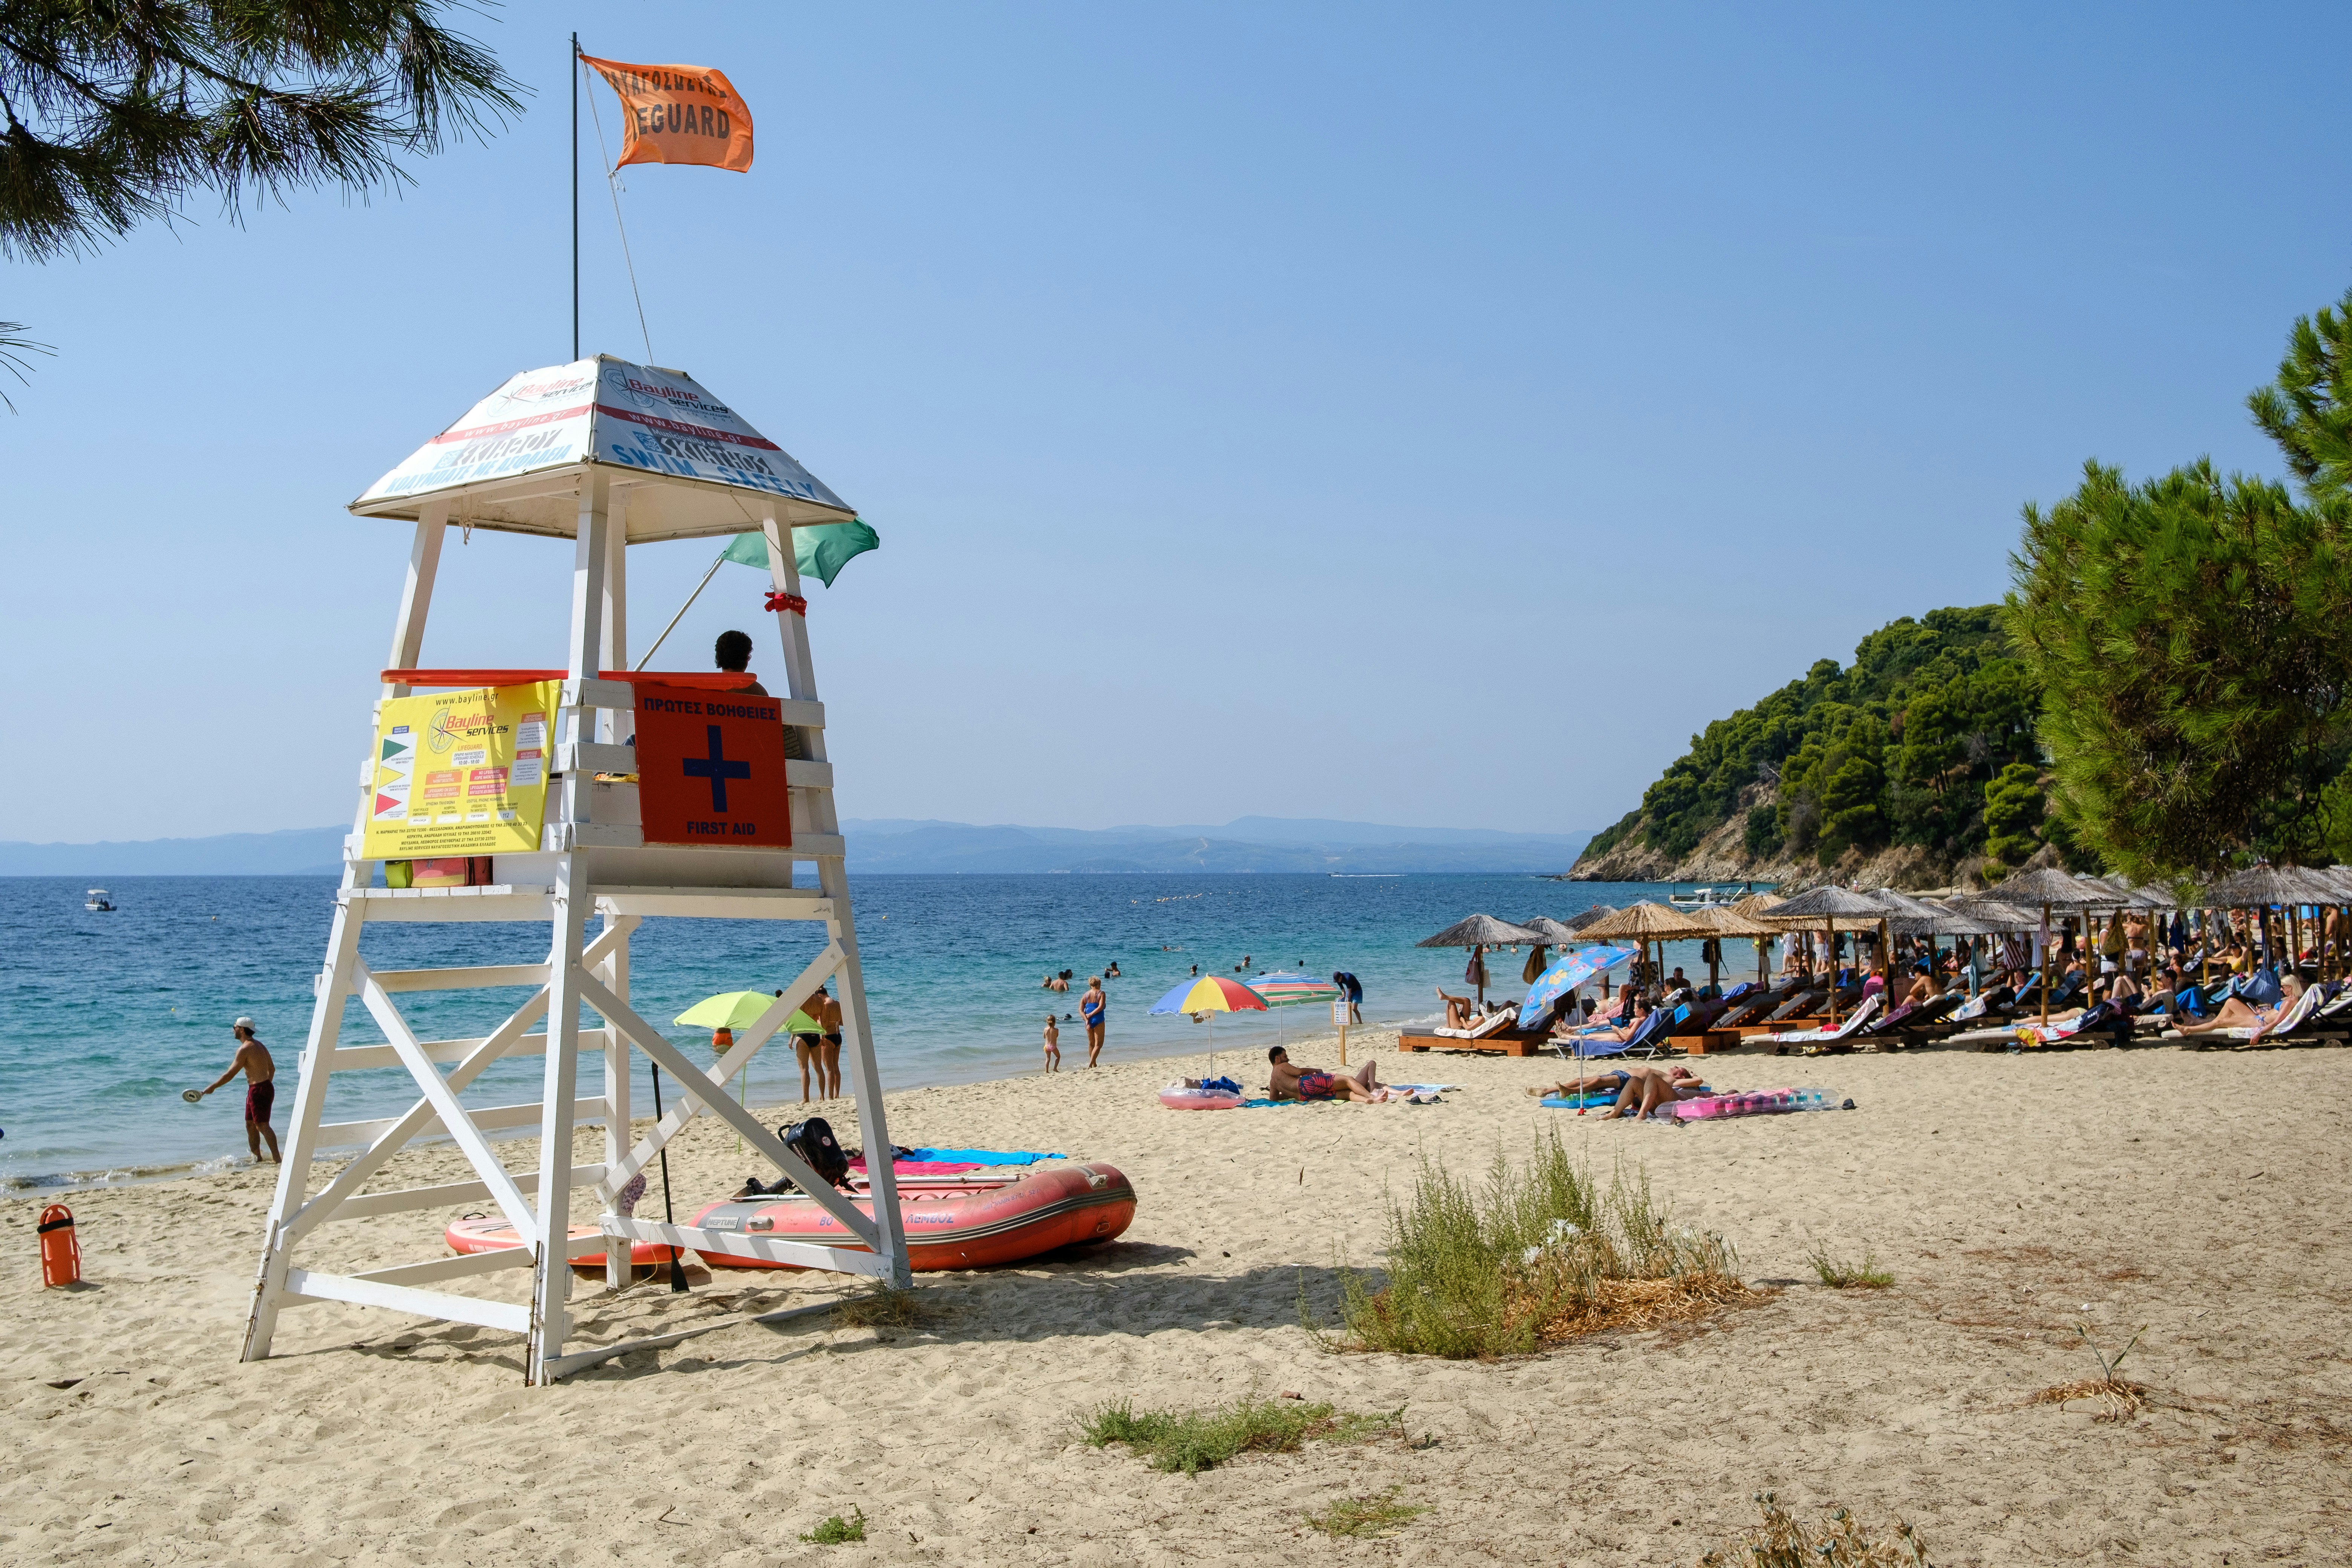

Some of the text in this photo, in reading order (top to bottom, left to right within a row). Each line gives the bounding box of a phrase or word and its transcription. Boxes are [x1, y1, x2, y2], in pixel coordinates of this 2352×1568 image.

[632, 104, 730, 142] EGUARD
[517, 377, 585, 396] Bayline
[539, 380, 594, 399] services
[628, 378, 698, 401] Bayline
[668, 398, 729, 414] services
[464, 410, 568, 438] www.bayline.gr
[628, 413, 741, 443] www.bayline.gr
[651, 428, 705, 446] Municipality
[660, 437, 771, 475] SKIATHOS
[384, 444, 573, 493] ΚΟΛΥΜΠΑΤΕ ΜΕ ΑΣΦΑΛΕΙΑ
[611, 444, 819, 500] SWIM SAFELY
[436, 693, 499, 706] www.bayline.gr
[644, 698, 776, 720] ΠΡΩΤΕΣ ΒΟΗΘΕΙΕΣ
[445, 713, 495, 731] Bayline
[466, 724, 509, 737] services
[687, 821, 756, 835] FIRST AID
[905, 1213, 955, 1223] ΛΕΜΒΟΣ
